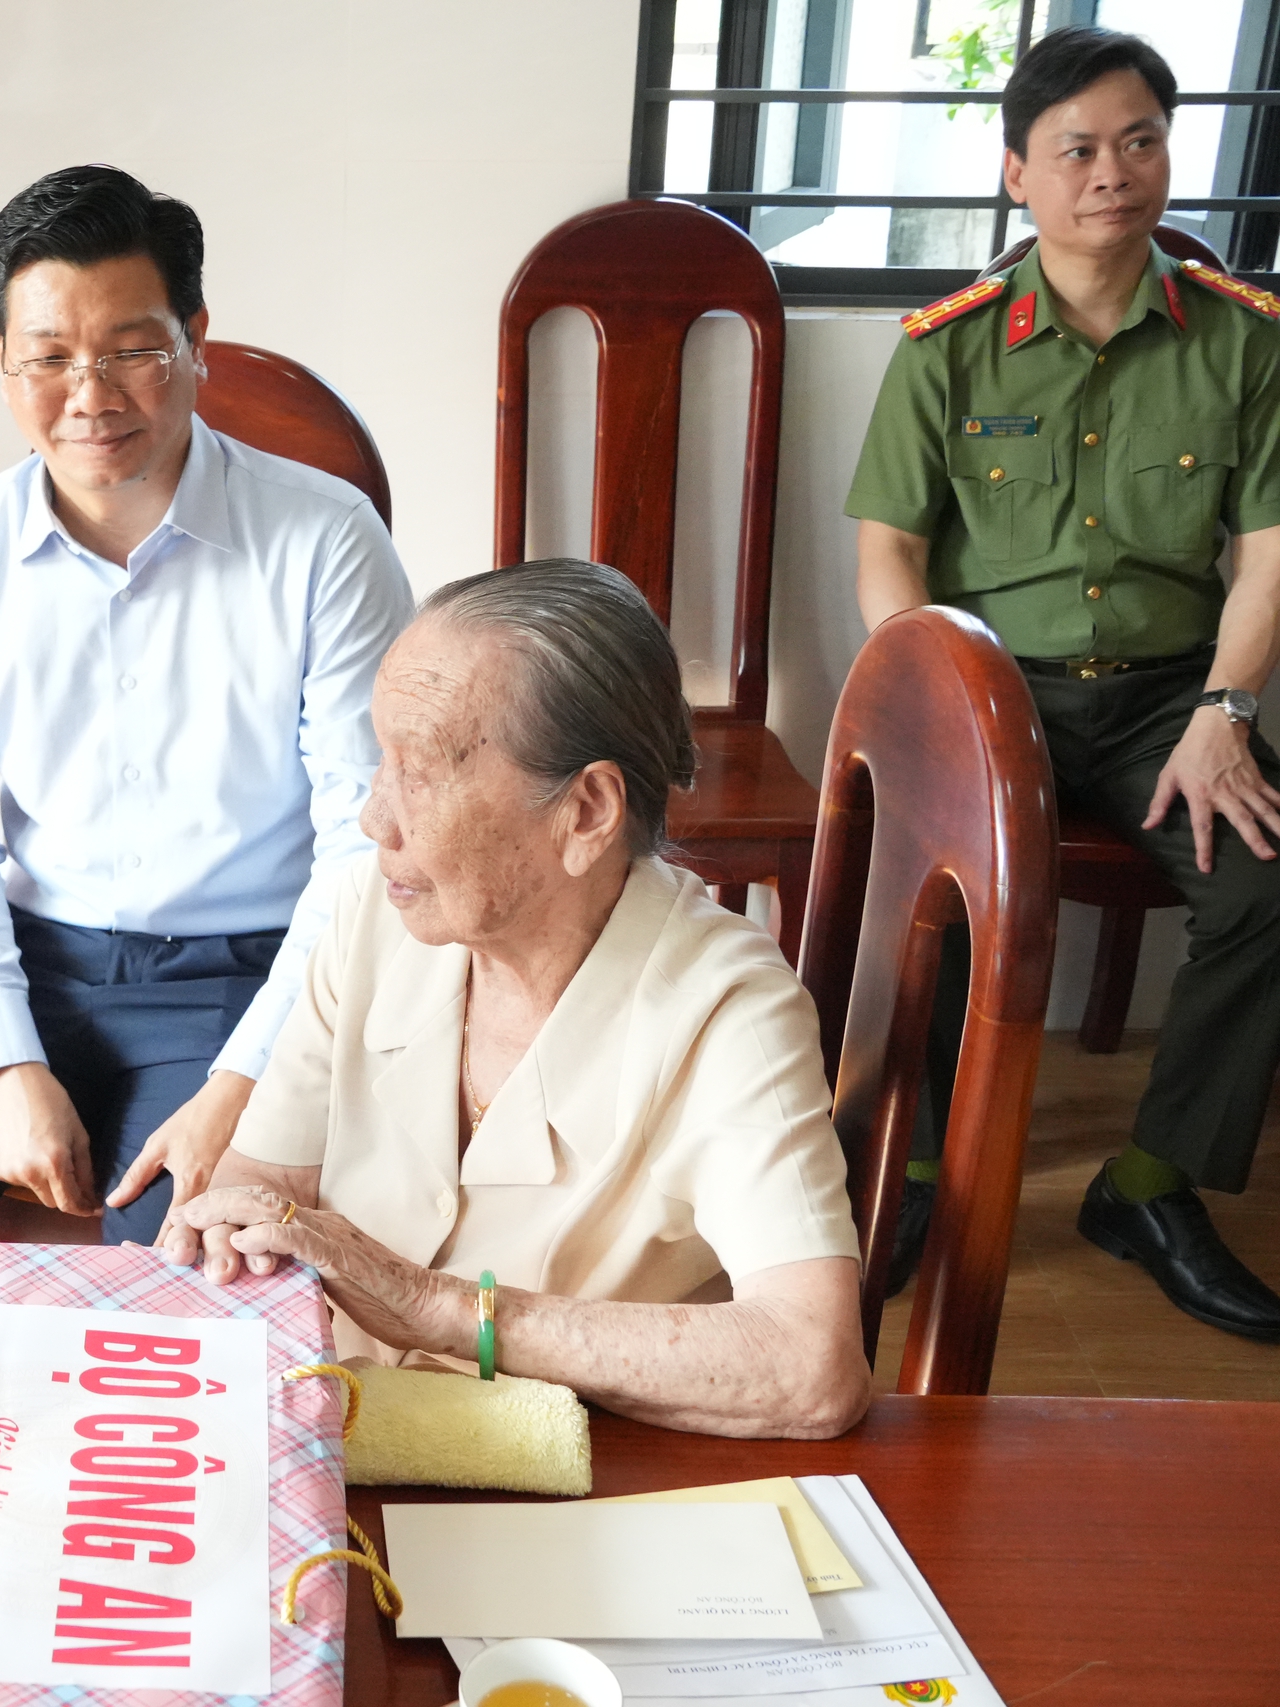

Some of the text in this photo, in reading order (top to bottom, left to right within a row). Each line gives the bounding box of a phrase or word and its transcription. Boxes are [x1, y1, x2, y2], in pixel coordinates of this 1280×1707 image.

[51, 1329, 228, 1668] BỘ CÔNG AN
[678, 1607, 718, 1615] QUANG
[766, 1669, 783, 1677] AN
